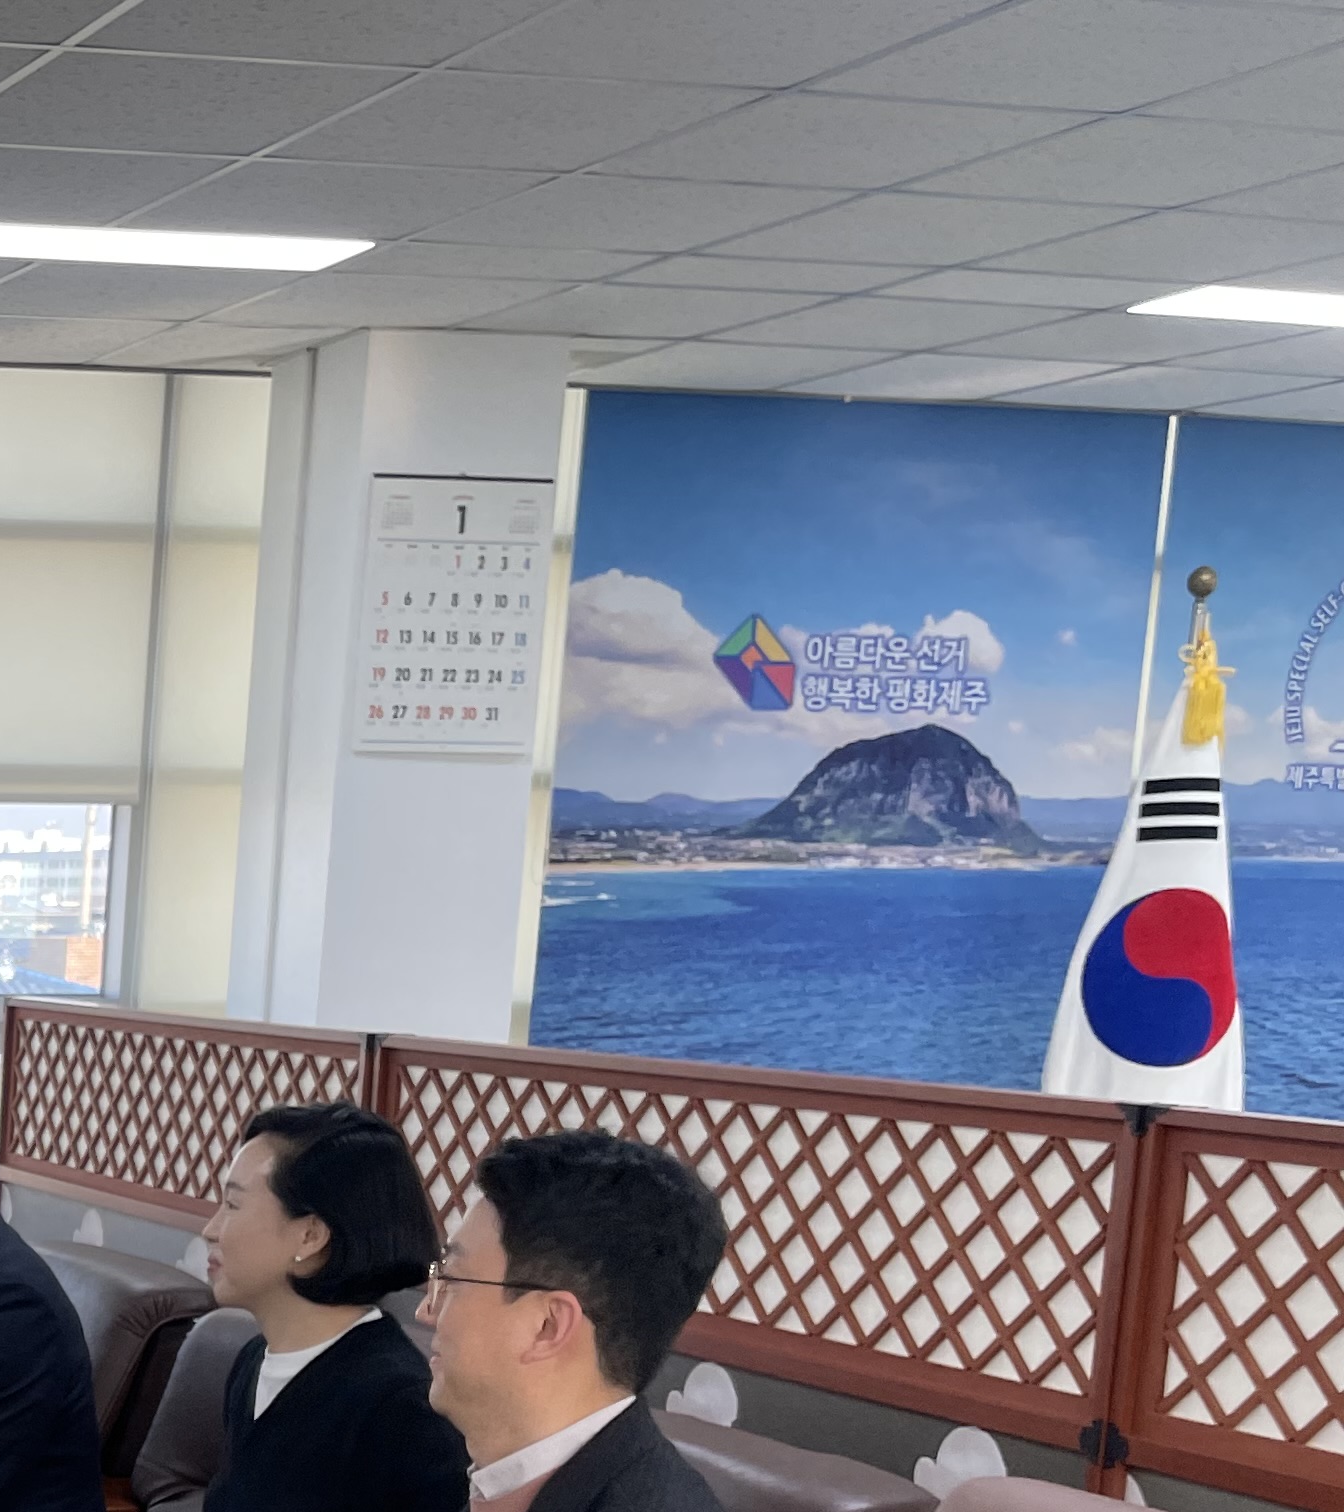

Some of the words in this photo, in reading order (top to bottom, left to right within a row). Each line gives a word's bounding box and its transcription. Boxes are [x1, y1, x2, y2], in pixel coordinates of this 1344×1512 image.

[457, 504, 466, 534] 1
[478, 555, 485, 570] 2
[501, 556, 508, 571] 3
[382, 591, 389, 605] 5
[404, 591, 412, 606] 6
[428, 592, 436, 606] 7
[451, 593, 459, 607] 8
[474, 593, 482, 608] 9
[495, 594, 508, 608] 10
[519, 594, 530, 609] 11
[376, 629, 389, 644] 12
[400, 630, 412, 644] 13
[423, 630, 435, 644] 14
[446, 631, 458, 645] 15
[469, 631, 481, 645] 16
[492, 632, 504, 646] 17
[515, 632, 527, 646] 18
[806, 635, 911, 671] 아름다운
[916, 638, 967, 672] 선거
[372, 667, 386, 681] 19
[395, 667, 411, 682] 20
[420, 667, 433, 682] 21
[442, 668, 457, 683] 22
[465, 669, 479, 683] 23
[488, 670, 502, 684] 24
[511, 670, 525, 684] 25
[803, 675, 882, 712] 행복한
[886, 677, 988, 716] 평화제주
[368, 704, 384, 719] 26
[392, 704, 408, 719] 27
[416, 705, 431, 720] 28
[439, 706, 454, 720] 29
[461, 706, 477, 721] 30
[485, 707, 498, 721] 31
